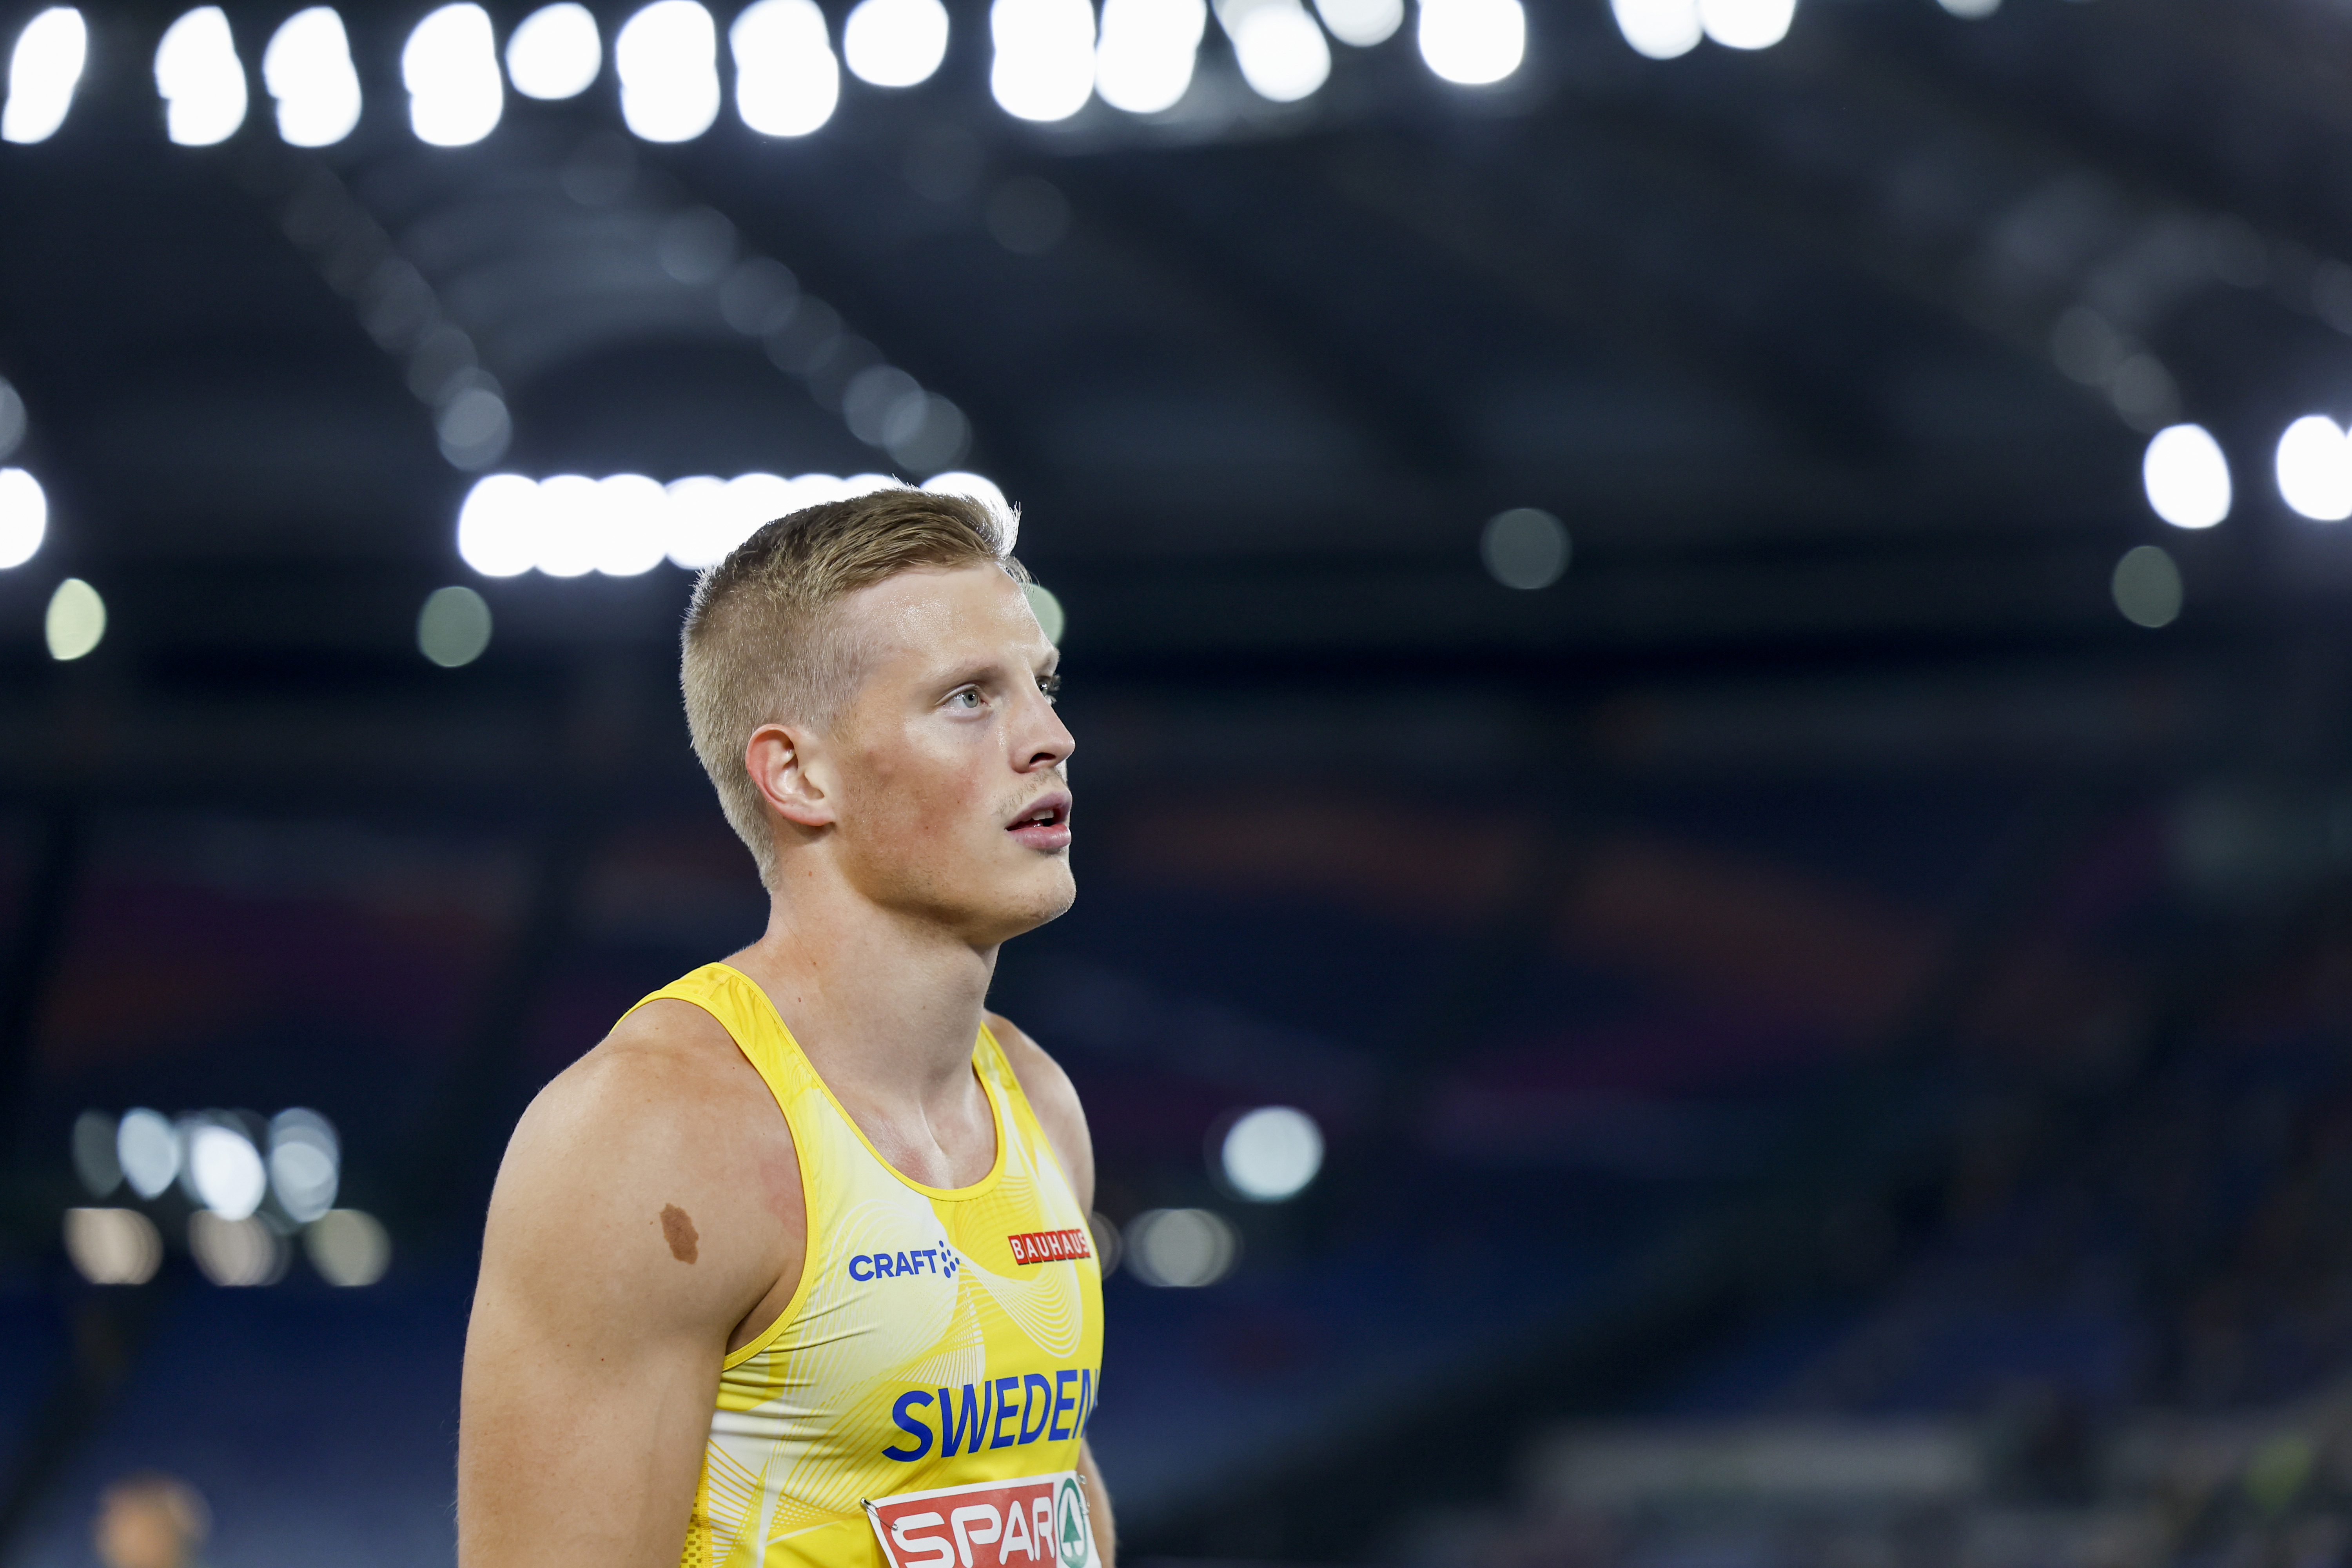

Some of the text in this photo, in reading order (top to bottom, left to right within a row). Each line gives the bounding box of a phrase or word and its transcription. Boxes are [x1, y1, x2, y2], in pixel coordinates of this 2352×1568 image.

[849, 1249, 937, 1281] CRAFT
[1010, 1231, 1089, 1259] BAUHAUS
[882, 1368, 1098, 1462] SWEDEN
[891, 1496, 1055, 1568] SPAR
